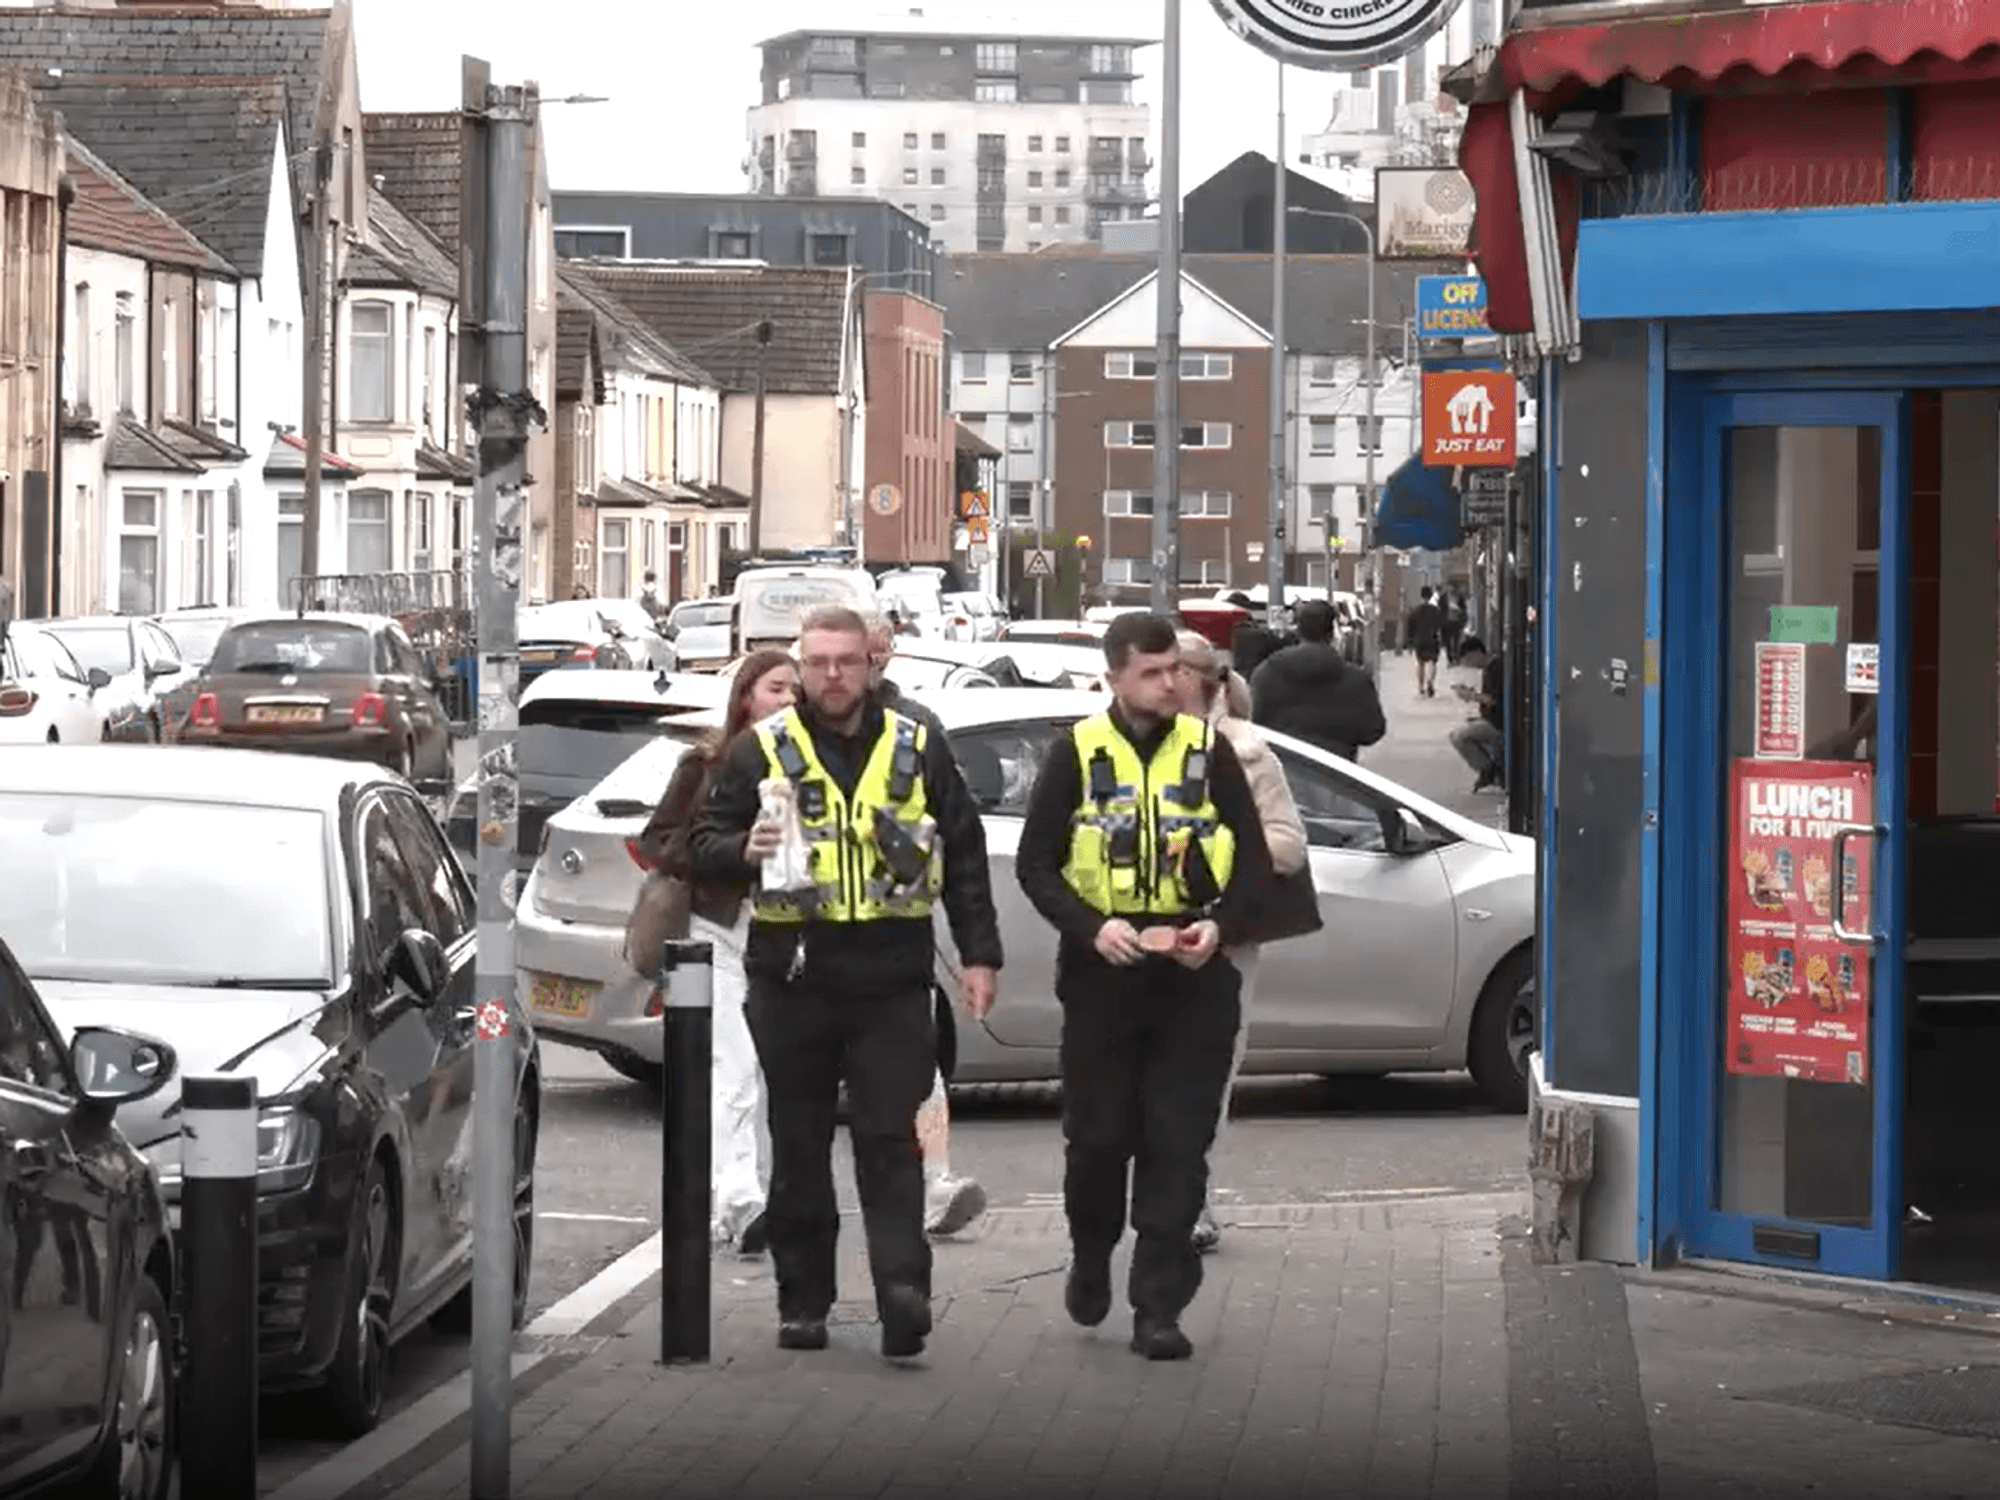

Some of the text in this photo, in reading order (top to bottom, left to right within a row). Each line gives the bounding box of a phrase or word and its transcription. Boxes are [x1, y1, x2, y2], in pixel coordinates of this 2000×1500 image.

[1442, 282, 1478, 304] OFF
[1434, 438, 1506, 453] JUST EAT
[1750, 782, 1853, 820] LUNCH
[1750, 817, 1785, 837] FOR
[1790, 818, 1801, 838] A
